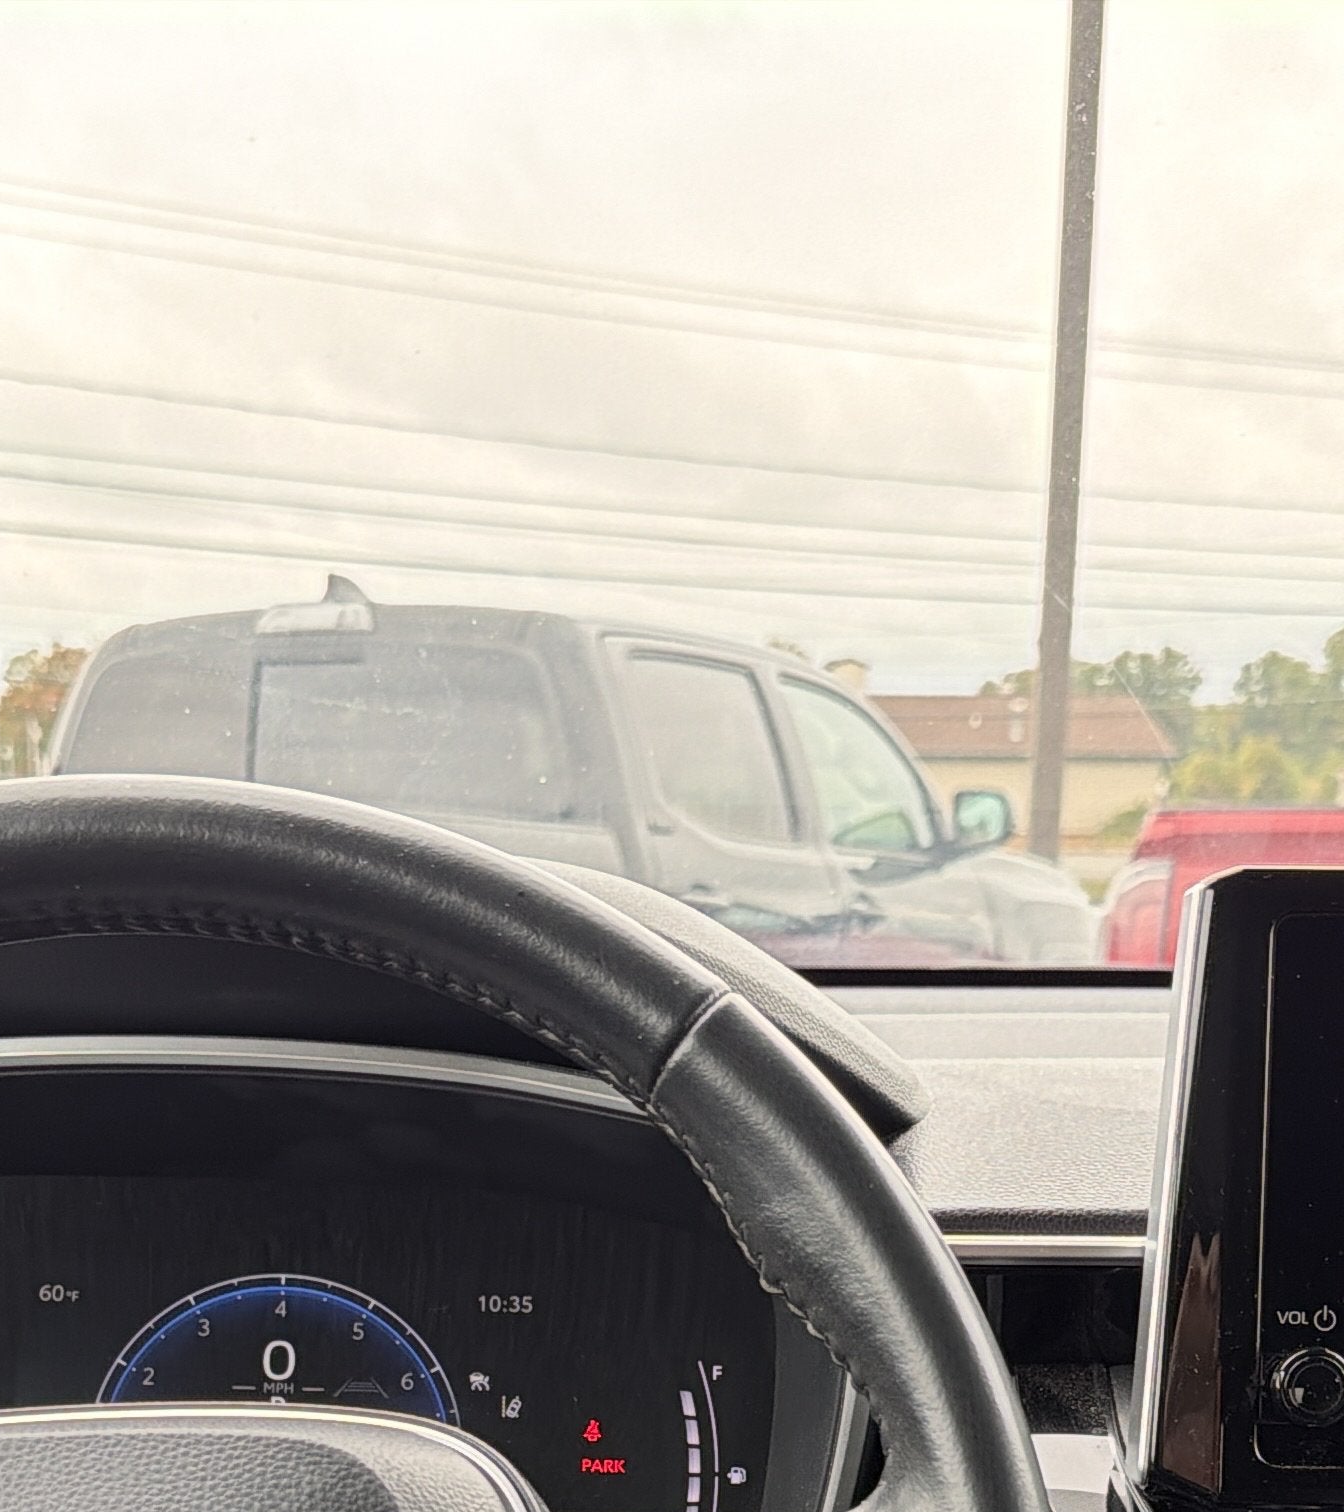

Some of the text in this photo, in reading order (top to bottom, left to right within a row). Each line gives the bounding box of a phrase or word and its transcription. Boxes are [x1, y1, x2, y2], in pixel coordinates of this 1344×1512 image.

[274, 1300, 288, 1318] 4
[478, 1295, 533, 1314] 10:35
[1276, 1310, 1310, 1325] VOL
[198, 1319, 210, 1338] 3
[352, 1322, 365, 1341] 5
[262, 1340, 296, 1381] 0
[143, 1367, 156, 1386] 2
[400, 1373, 414, 1390] 6
[712, 1365, 723, 1381] F
[263, 1382, 295, 1395] MPH
[581, 1459, 626, 1474] PARK
